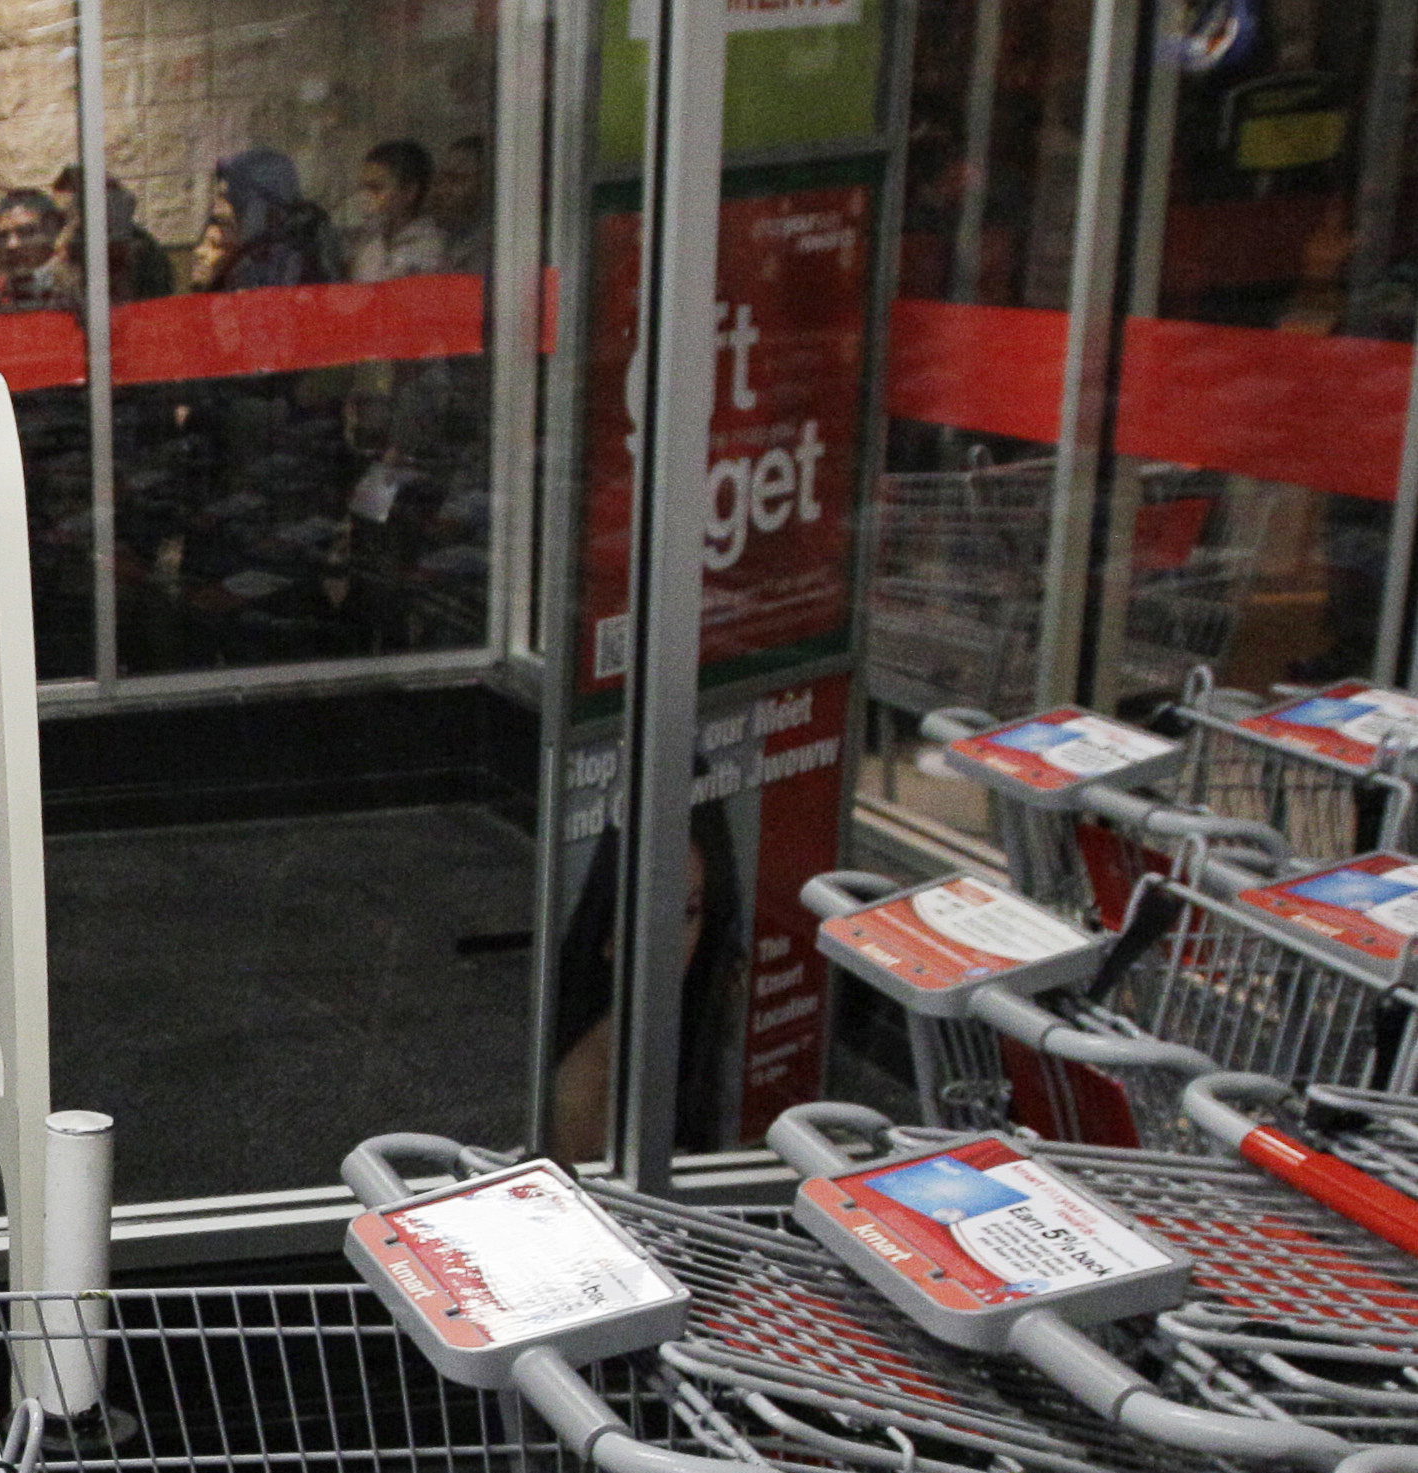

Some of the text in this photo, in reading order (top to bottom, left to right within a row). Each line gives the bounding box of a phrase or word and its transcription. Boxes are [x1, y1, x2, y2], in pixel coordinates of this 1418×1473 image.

[854, 1223, 913, 1263] kmart
[1008, 1206, 1046, 1230] Earn
[1041, 1228, 1076, 1252] 5%
[1070, 1251, 1110, 1277] back
[388, 1259, 437, 1300] kmart
